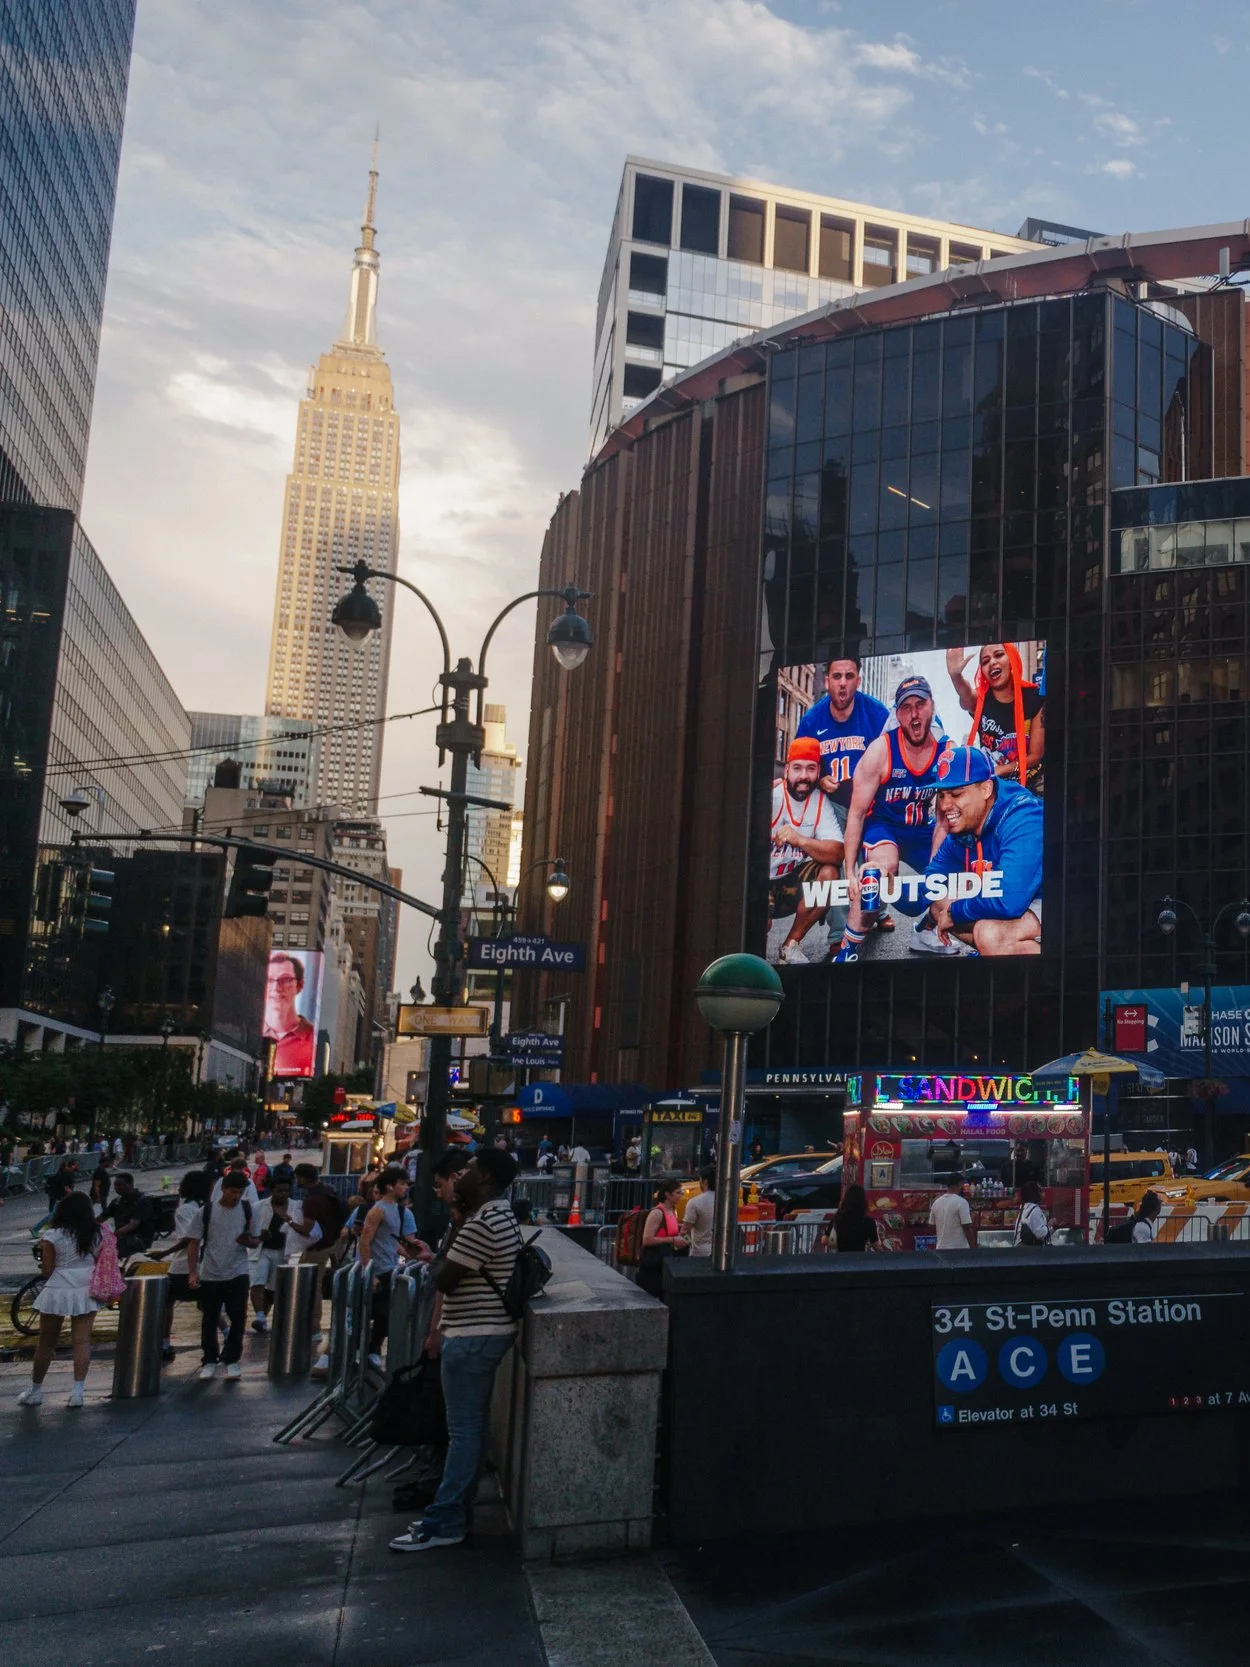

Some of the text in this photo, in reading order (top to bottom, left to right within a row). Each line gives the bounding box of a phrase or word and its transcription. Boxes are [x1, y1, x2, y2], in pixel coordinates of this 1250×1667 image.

[830, 756, 851, 782] 11
[802, 879, 850, 908] WE
[480, 944, 574, 964] Eighth Ave
[414, 1015, 437, 1025] ONE
[1211, 1010, 1242, 1020] HASE
[512, 1036, 560, 1047] Eighth Ave
[526, 1057, 546, 1065] Louis
[534, 1088, 543, 1104] D
[656, 1111, 686, 1120] TAXI
[934, 1299, 1202, 1334] 34 St-Penn Station
[950, 1343, 1093, 1381] A C E
[1208, 1392, 1221, 1405] at
[1225, 1391, 1233, 1404] 7
[958, 1402, 1079, 1423] Elevator at 34 St
